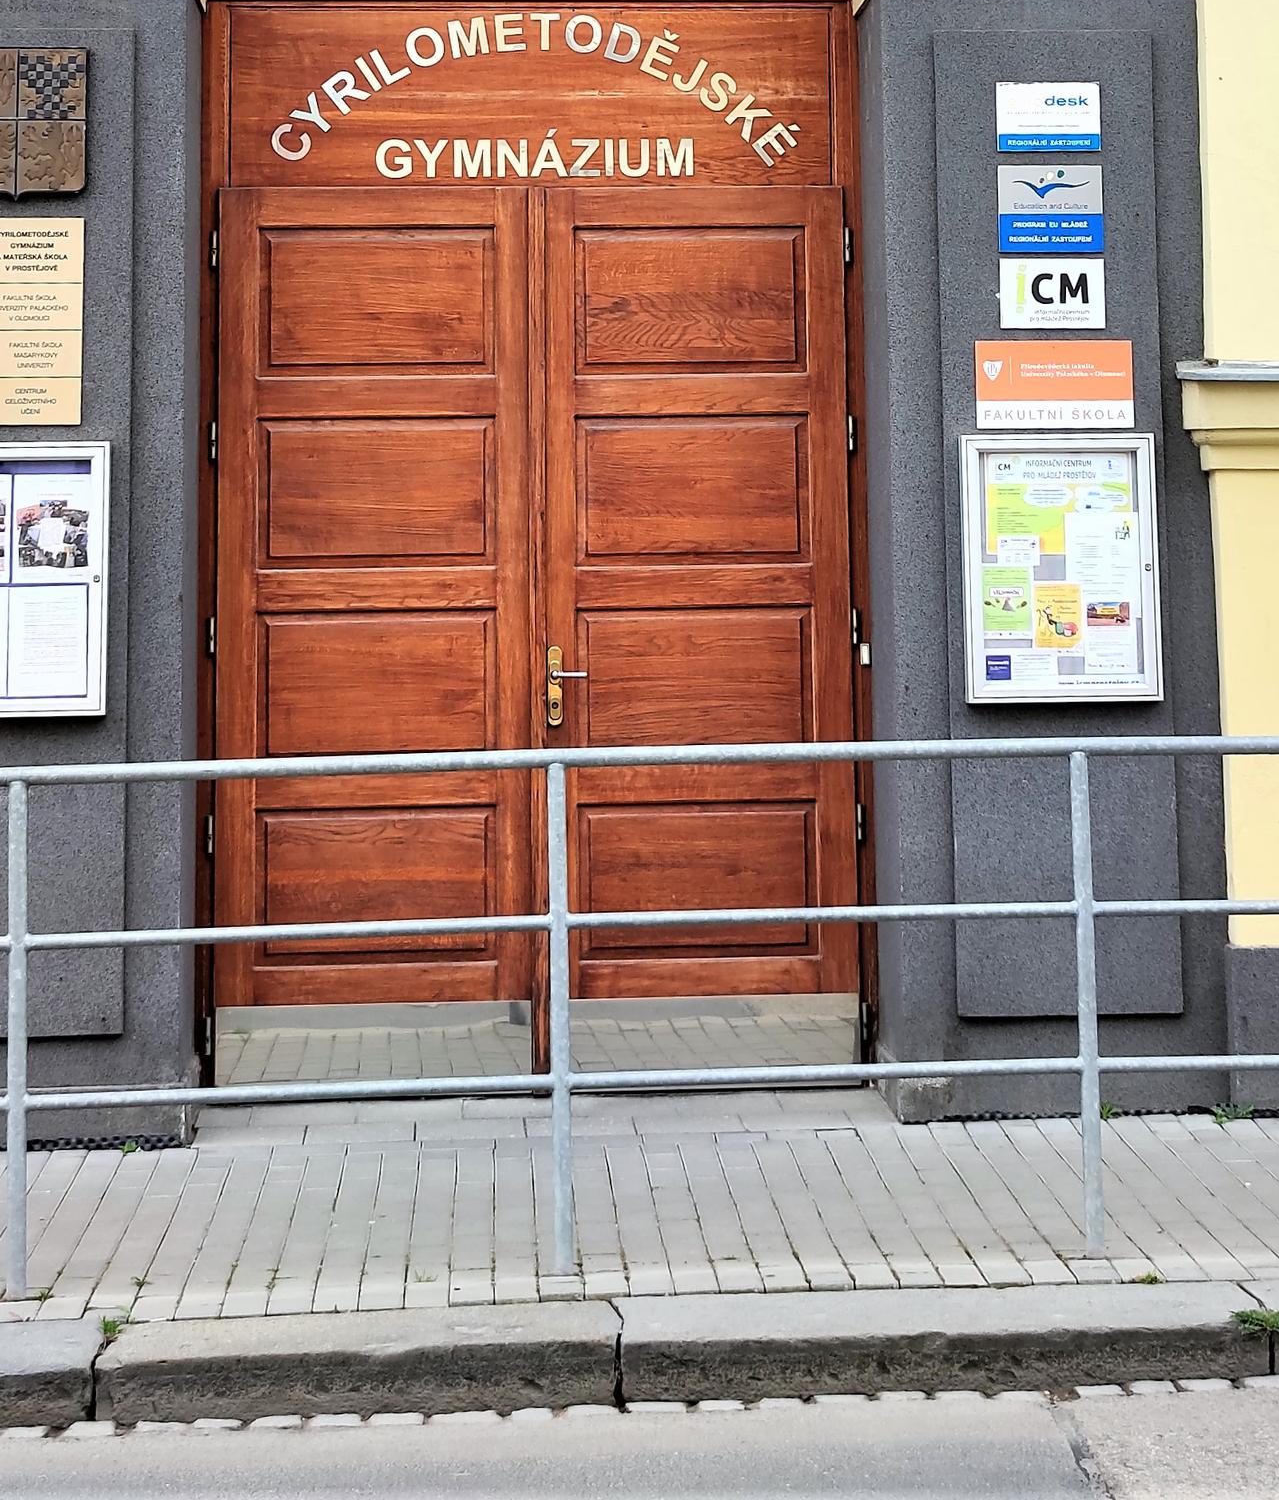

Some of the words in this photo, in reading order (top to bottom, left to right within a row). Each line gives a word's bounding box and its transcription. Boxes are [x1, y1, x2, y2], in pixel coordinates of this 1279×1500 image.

[270, 12, 802, 169] CYRILOMETODĚJSKÉ
[1044, 95, 1089, 106] desk
[375, 129, 695, 179] GYMNÁZIUM
[1013, 202, 1048, 210] Education
[1049, 202, 1062, 210] and
[1063, 202, 1089, 210] Culture
[984, 407, 1063, 420] FAKULTNÍ
[1072, 407, 1126, 420] ŠKOLA
